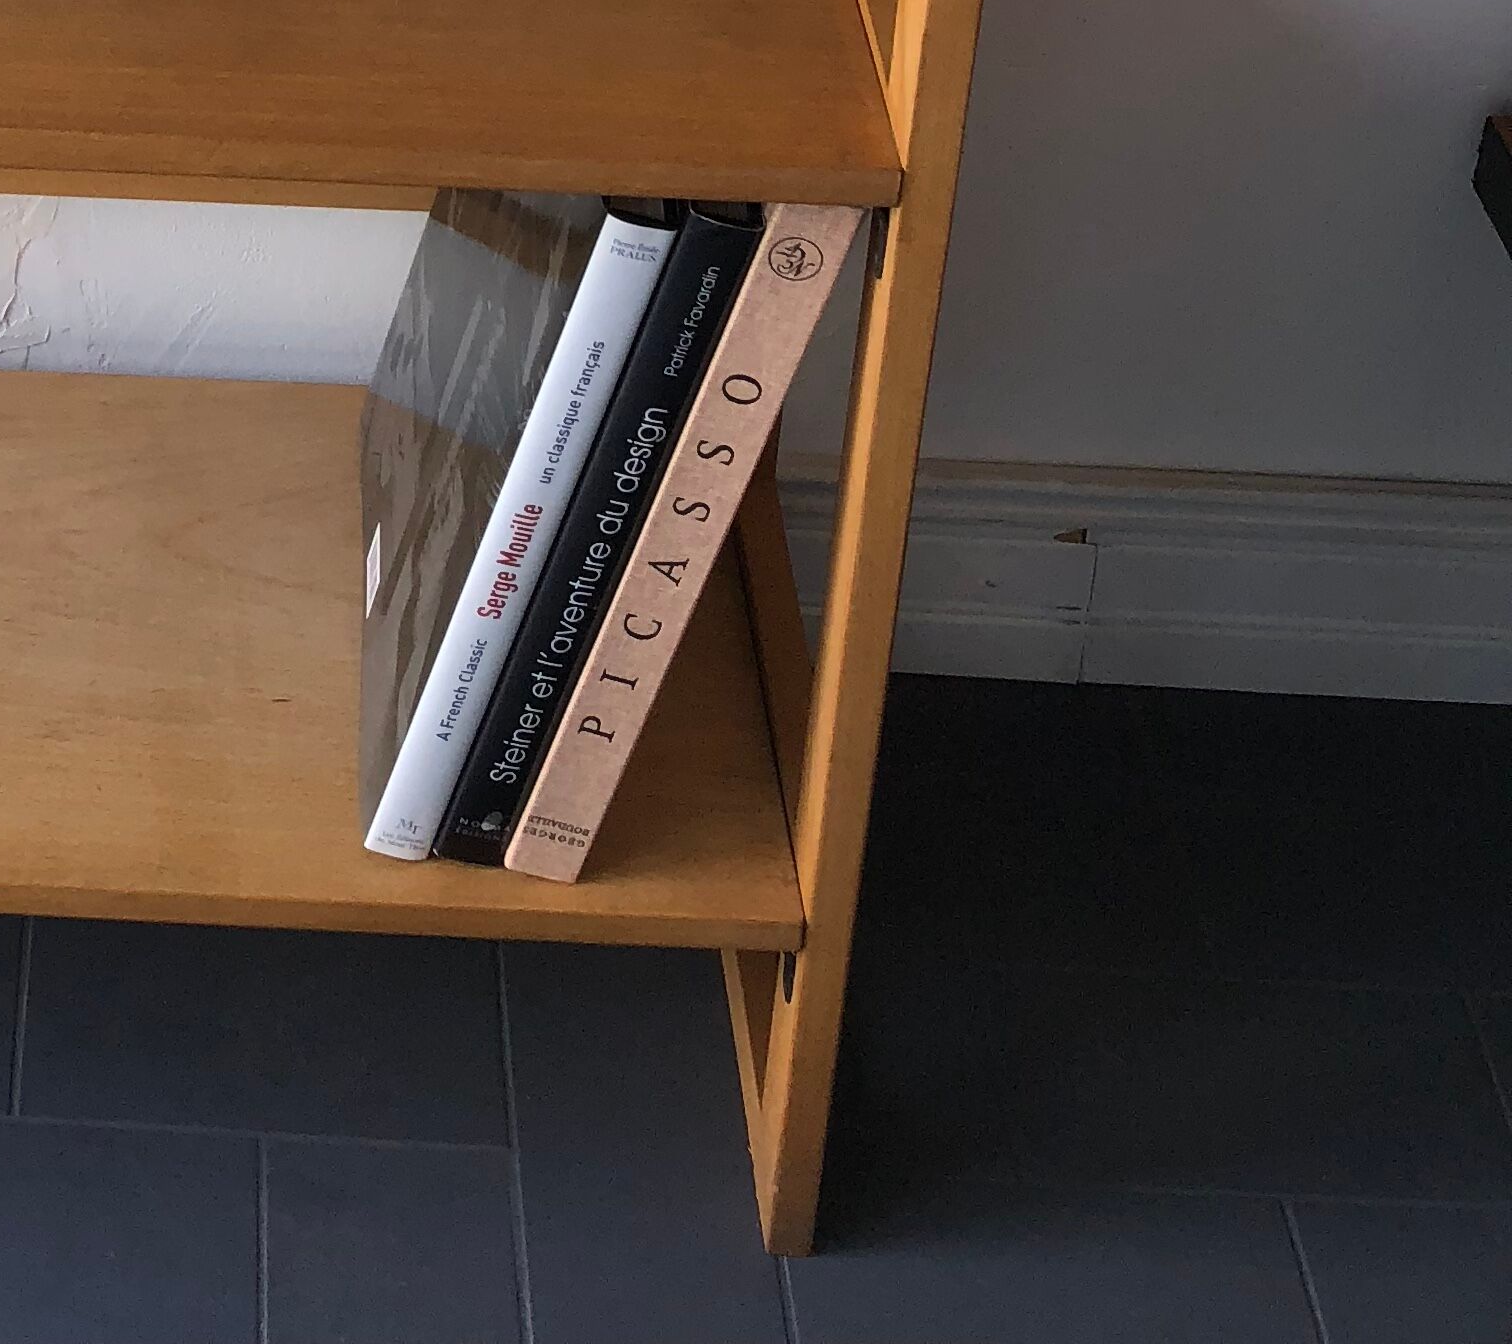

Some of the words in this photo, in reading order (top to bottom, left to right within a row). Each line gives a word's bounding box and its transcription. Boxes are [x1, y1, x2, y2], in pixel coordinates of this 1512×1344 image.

[663, 326, 695, 378] Patrick
[681, 265, 721, 328] Favardin
[539, 466, 552, 484] un
[546, 397, 582, 465] classique
[573, 340, 605, 398] français
[477, 571, 519, 620] Serge
[506, 503, 544, 569] Mouille
[490, 703, 544, 784] Steiner
[531, 670, 557, 699] et
[599, 498, 629, 536] du
[614, 406, 668, 494] design
[578, 374, 762, 743] PICASSO
[441, 685, 470, 729] French
[458, 638, 488, 684] Classic
[439, 728, 450, 742] A
[523, 826, 586, 848] GEORGES
